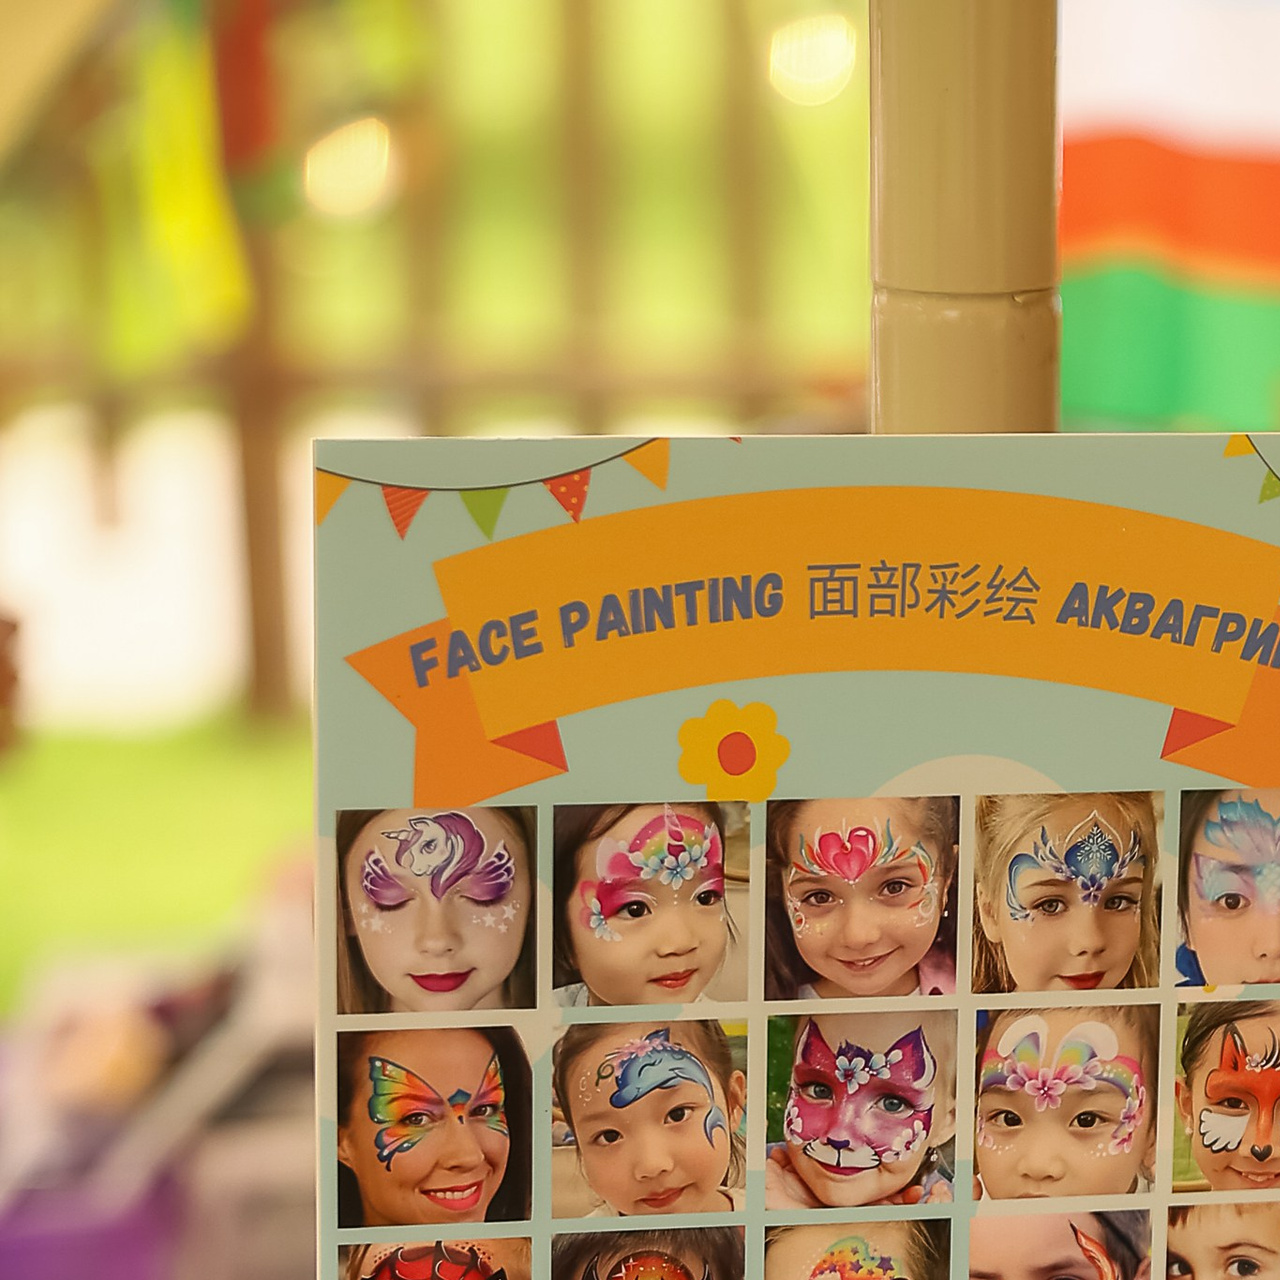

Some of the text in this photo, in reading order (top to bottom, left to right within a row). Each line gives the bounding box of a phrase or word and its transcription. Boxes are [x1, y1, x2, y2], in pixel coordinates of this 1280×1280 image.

[410, 609, 544, 688] FACE
[559, 572, 784, 649] PAINTING
[807, 559, 1041, 626] 面部彩绘
